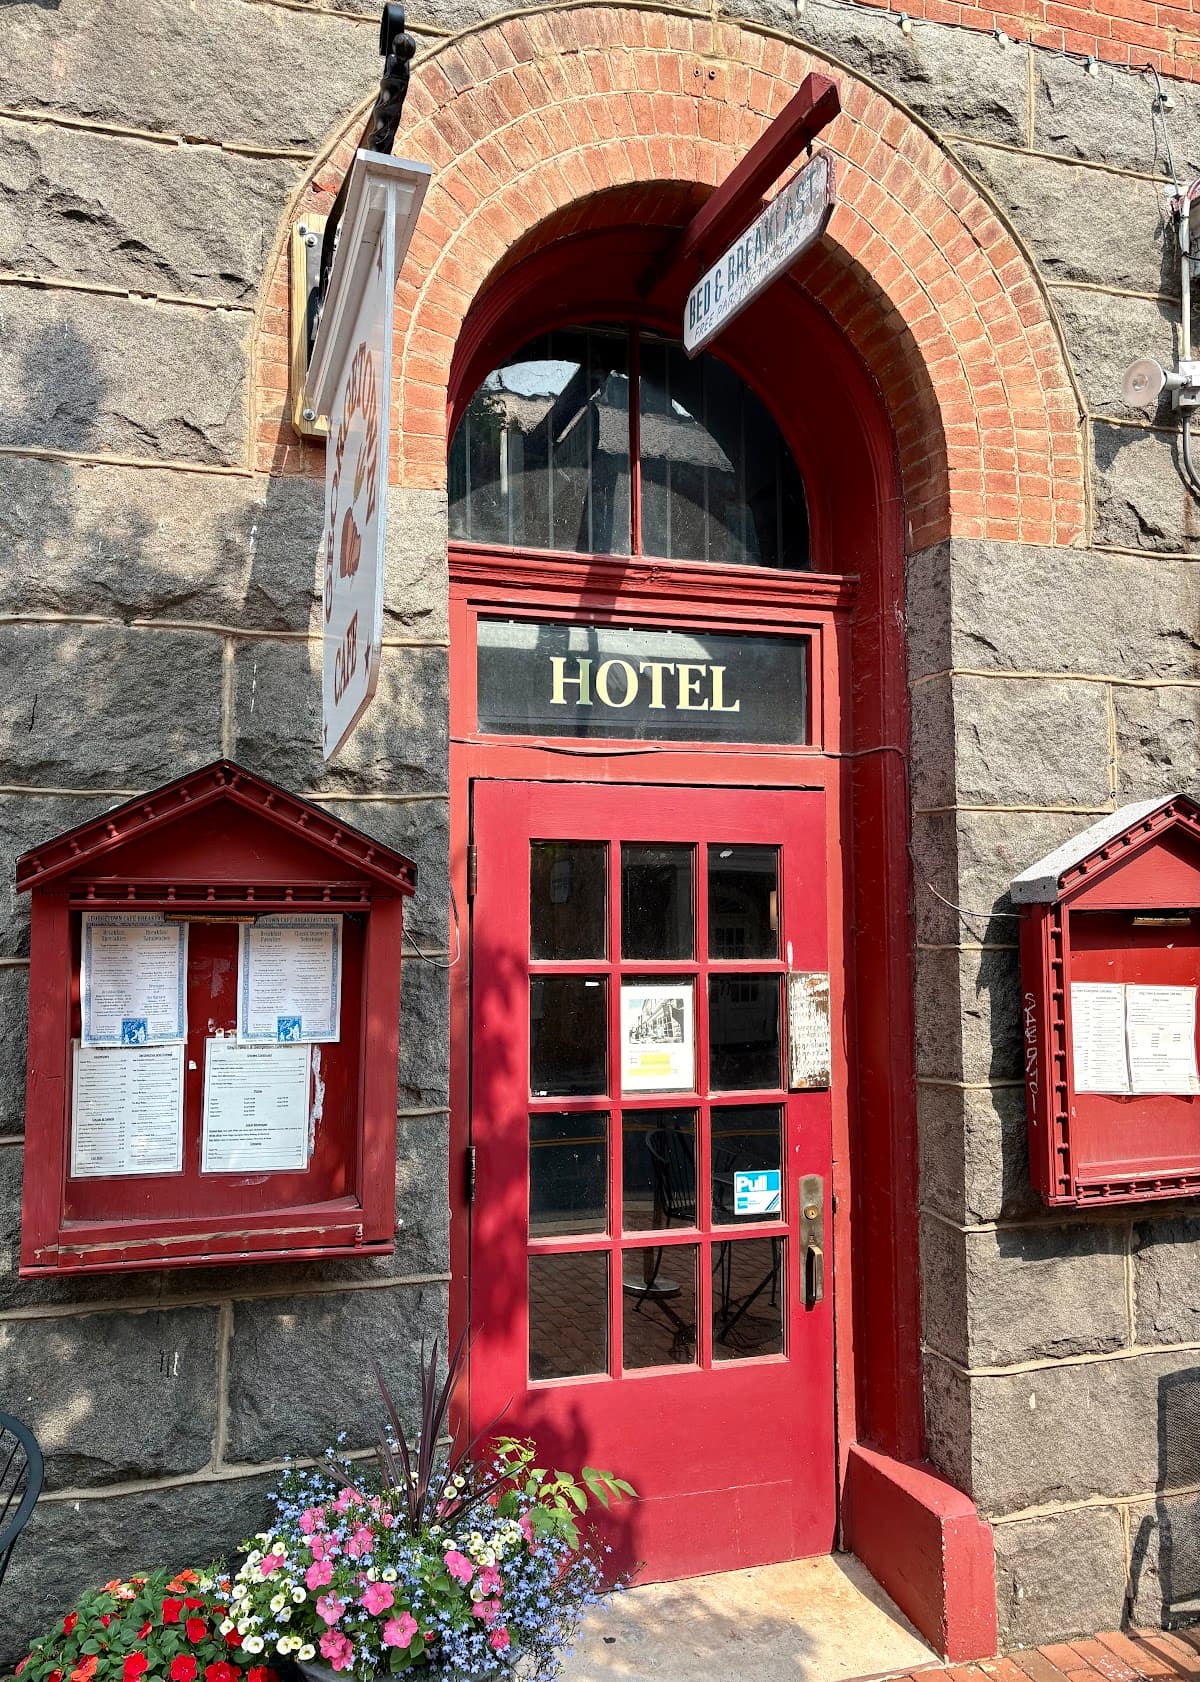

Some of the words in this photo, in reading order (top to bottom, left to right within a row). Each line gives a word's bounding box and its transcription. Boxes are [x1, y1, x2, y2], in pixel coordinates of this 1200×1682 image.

[688, 281, 712, 330] BED
[713, 267, 725, 303] &
[727, 168, 817, 293] BREAKFAST
[694, 311, 715, 341] FREE
[549, 655, 741, 712] HOTEL
[736, 1174, 768, 1193] Pull
